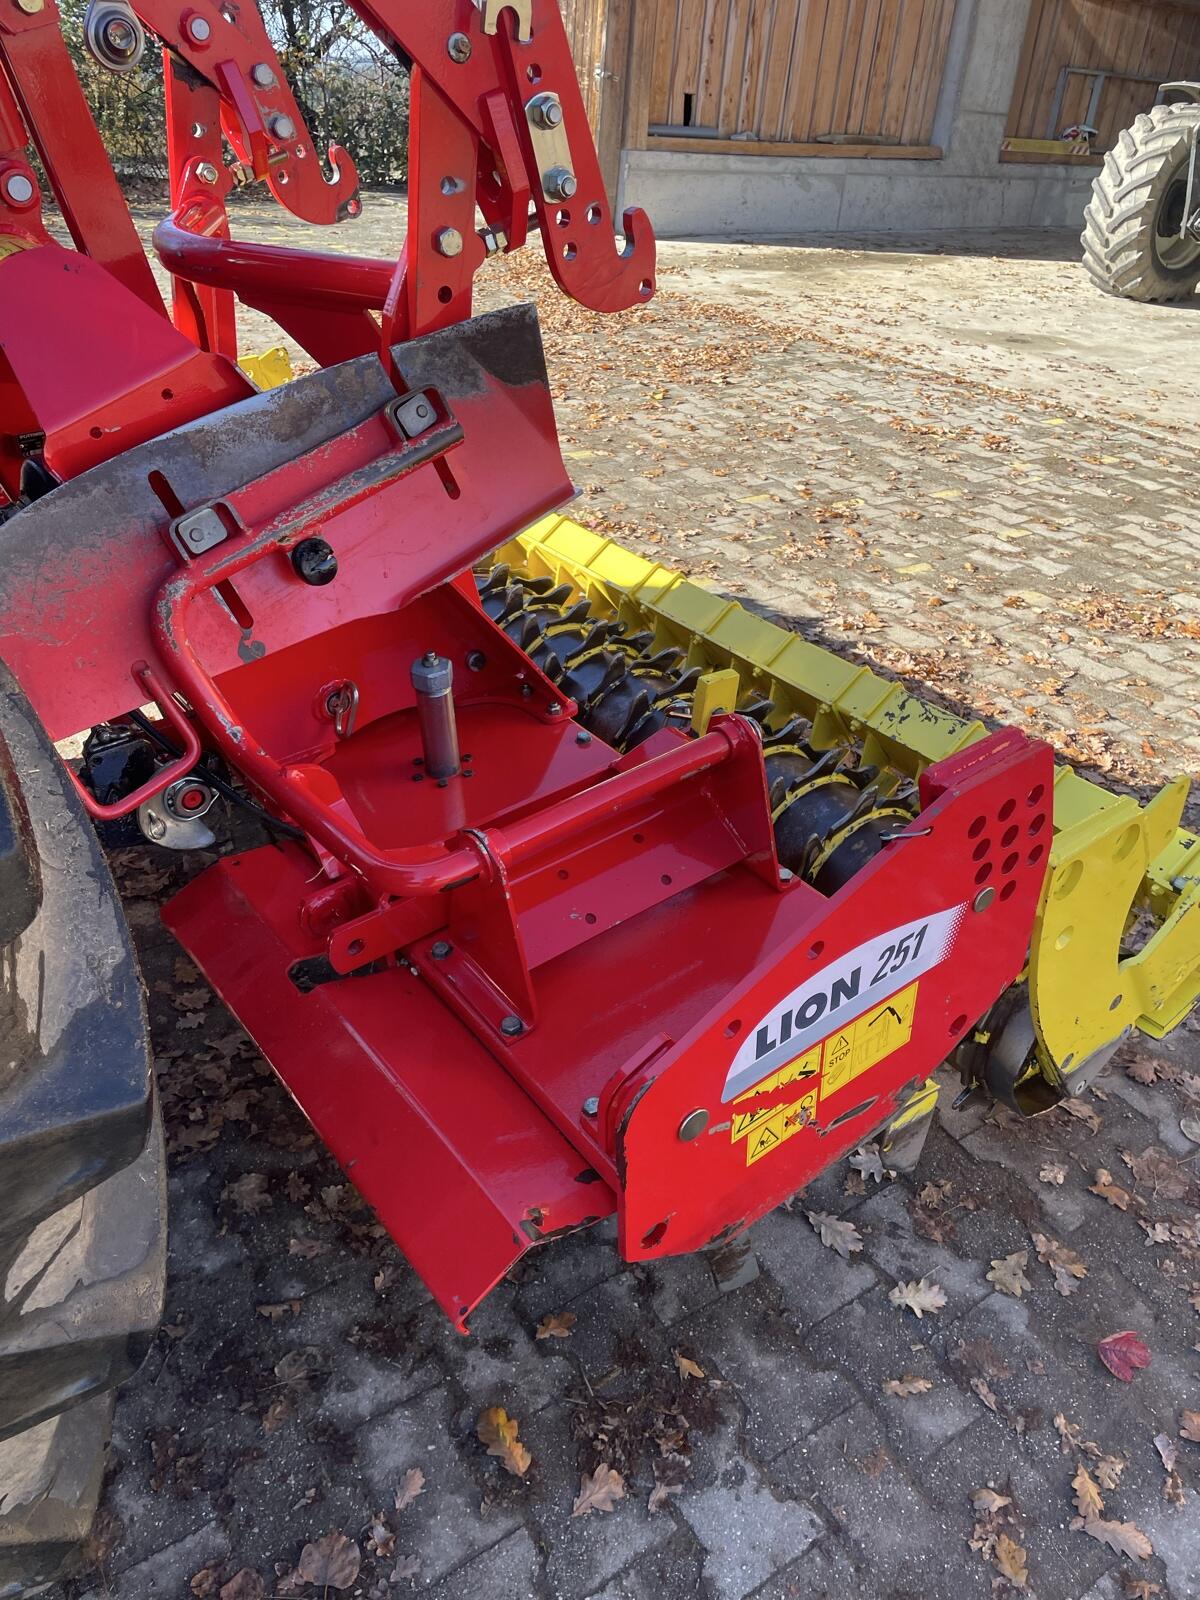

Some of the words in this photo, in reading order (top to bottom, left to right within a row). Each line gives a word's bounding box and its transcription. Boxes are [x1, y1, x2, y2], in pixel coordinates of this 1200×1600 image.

[755, 967, 862, 1060] LION
[869, 924, 929, 987] 251
[828, 1048, 851, 1068] STOP
